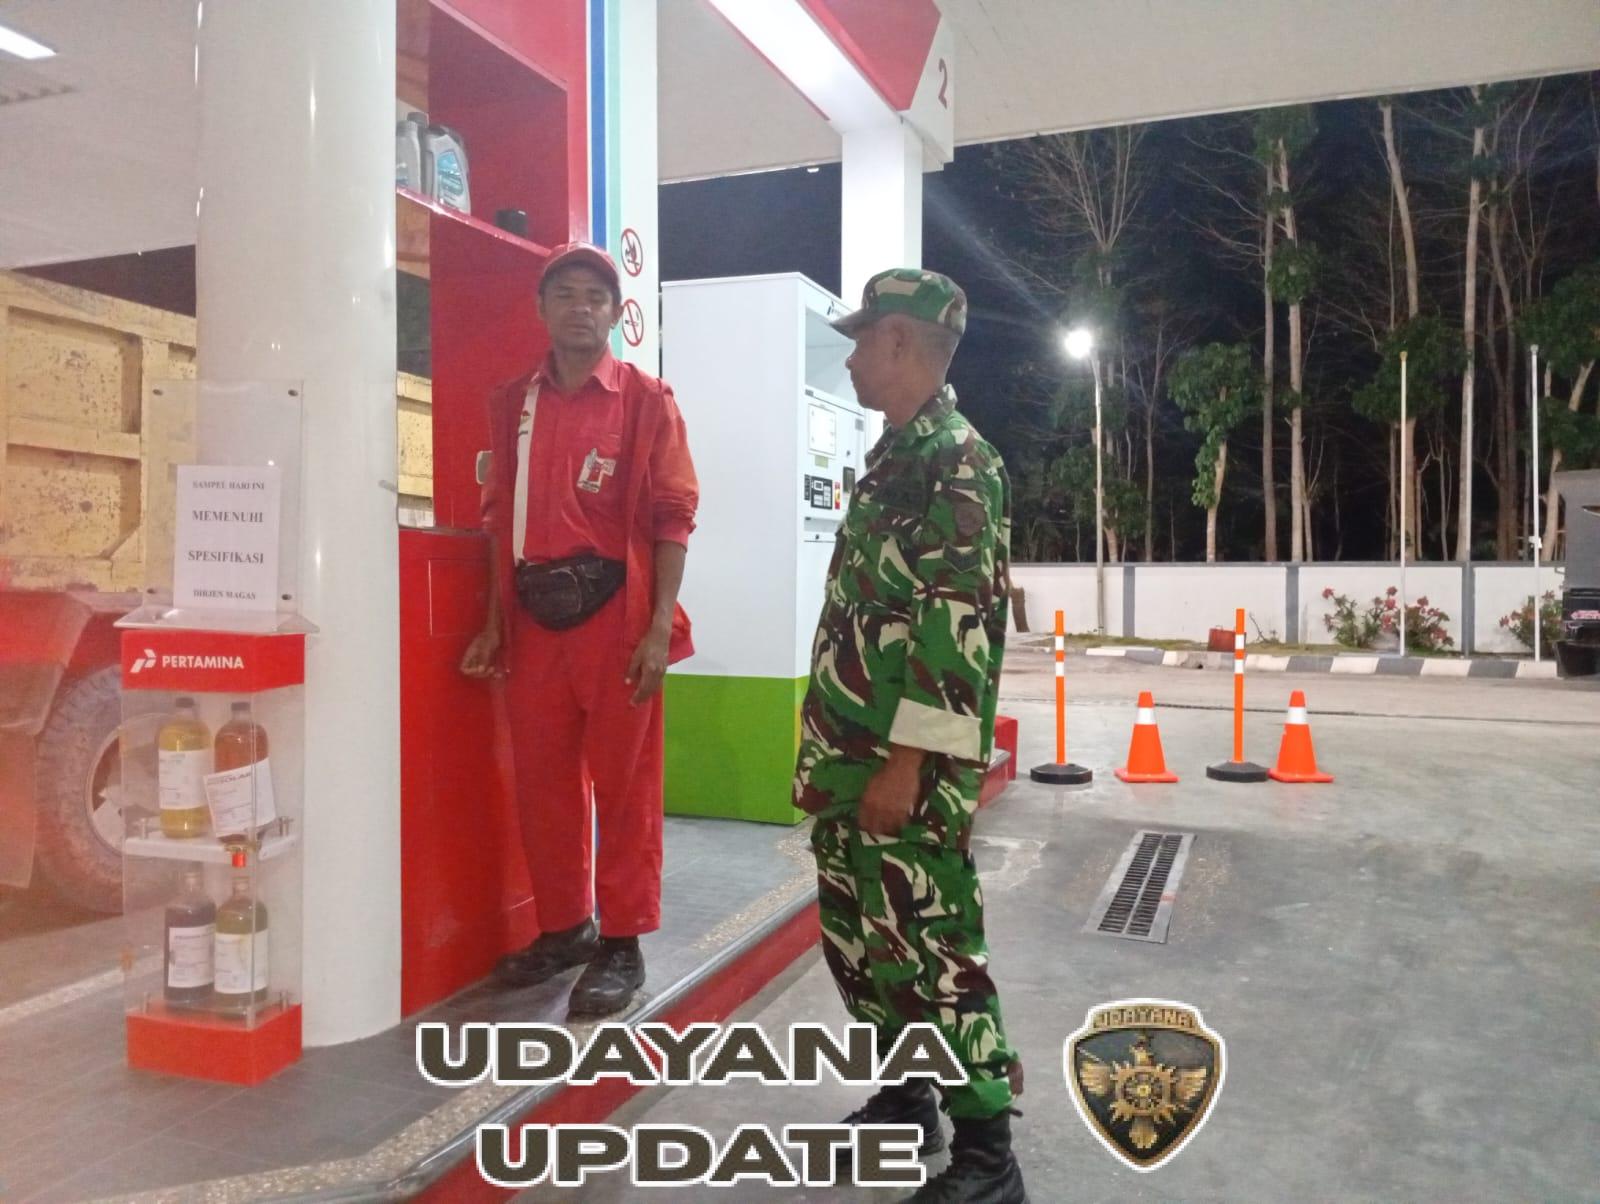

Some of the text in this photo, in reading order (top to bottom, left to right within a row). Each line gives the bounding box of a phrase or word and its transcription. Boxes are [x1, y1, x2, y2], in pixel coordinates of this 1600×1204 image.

[938, 57, 948, 110] 2
[192, 510, 264, 523] MEMENUHI
[188, 550, 265, 564] SPESIFIKASI
[162, 655, 245, 669] PERTAMINA
